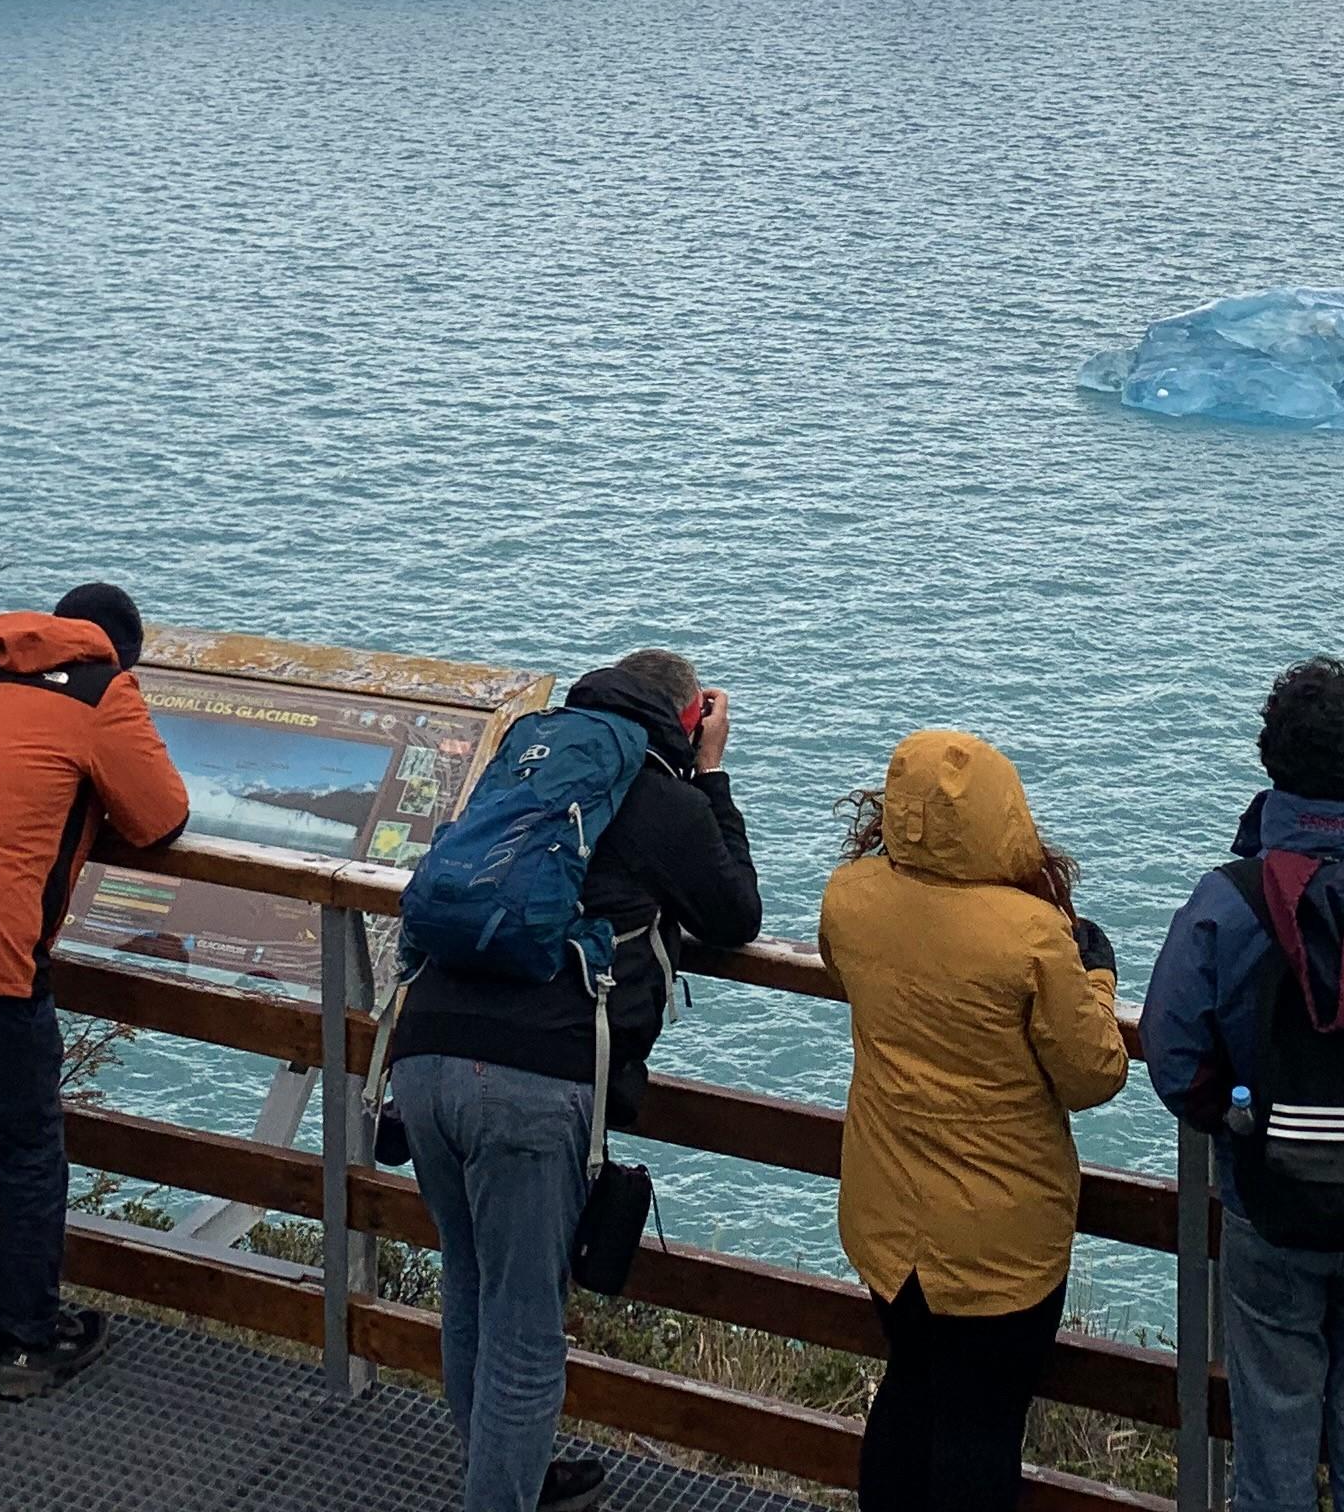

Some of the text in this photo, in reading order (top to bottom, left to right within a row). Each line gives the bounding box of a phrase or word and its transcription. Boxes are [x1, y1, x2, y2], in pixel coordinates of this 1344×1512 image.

[142, 694, 320, 727] ACIONAL LOS GLACIARES
